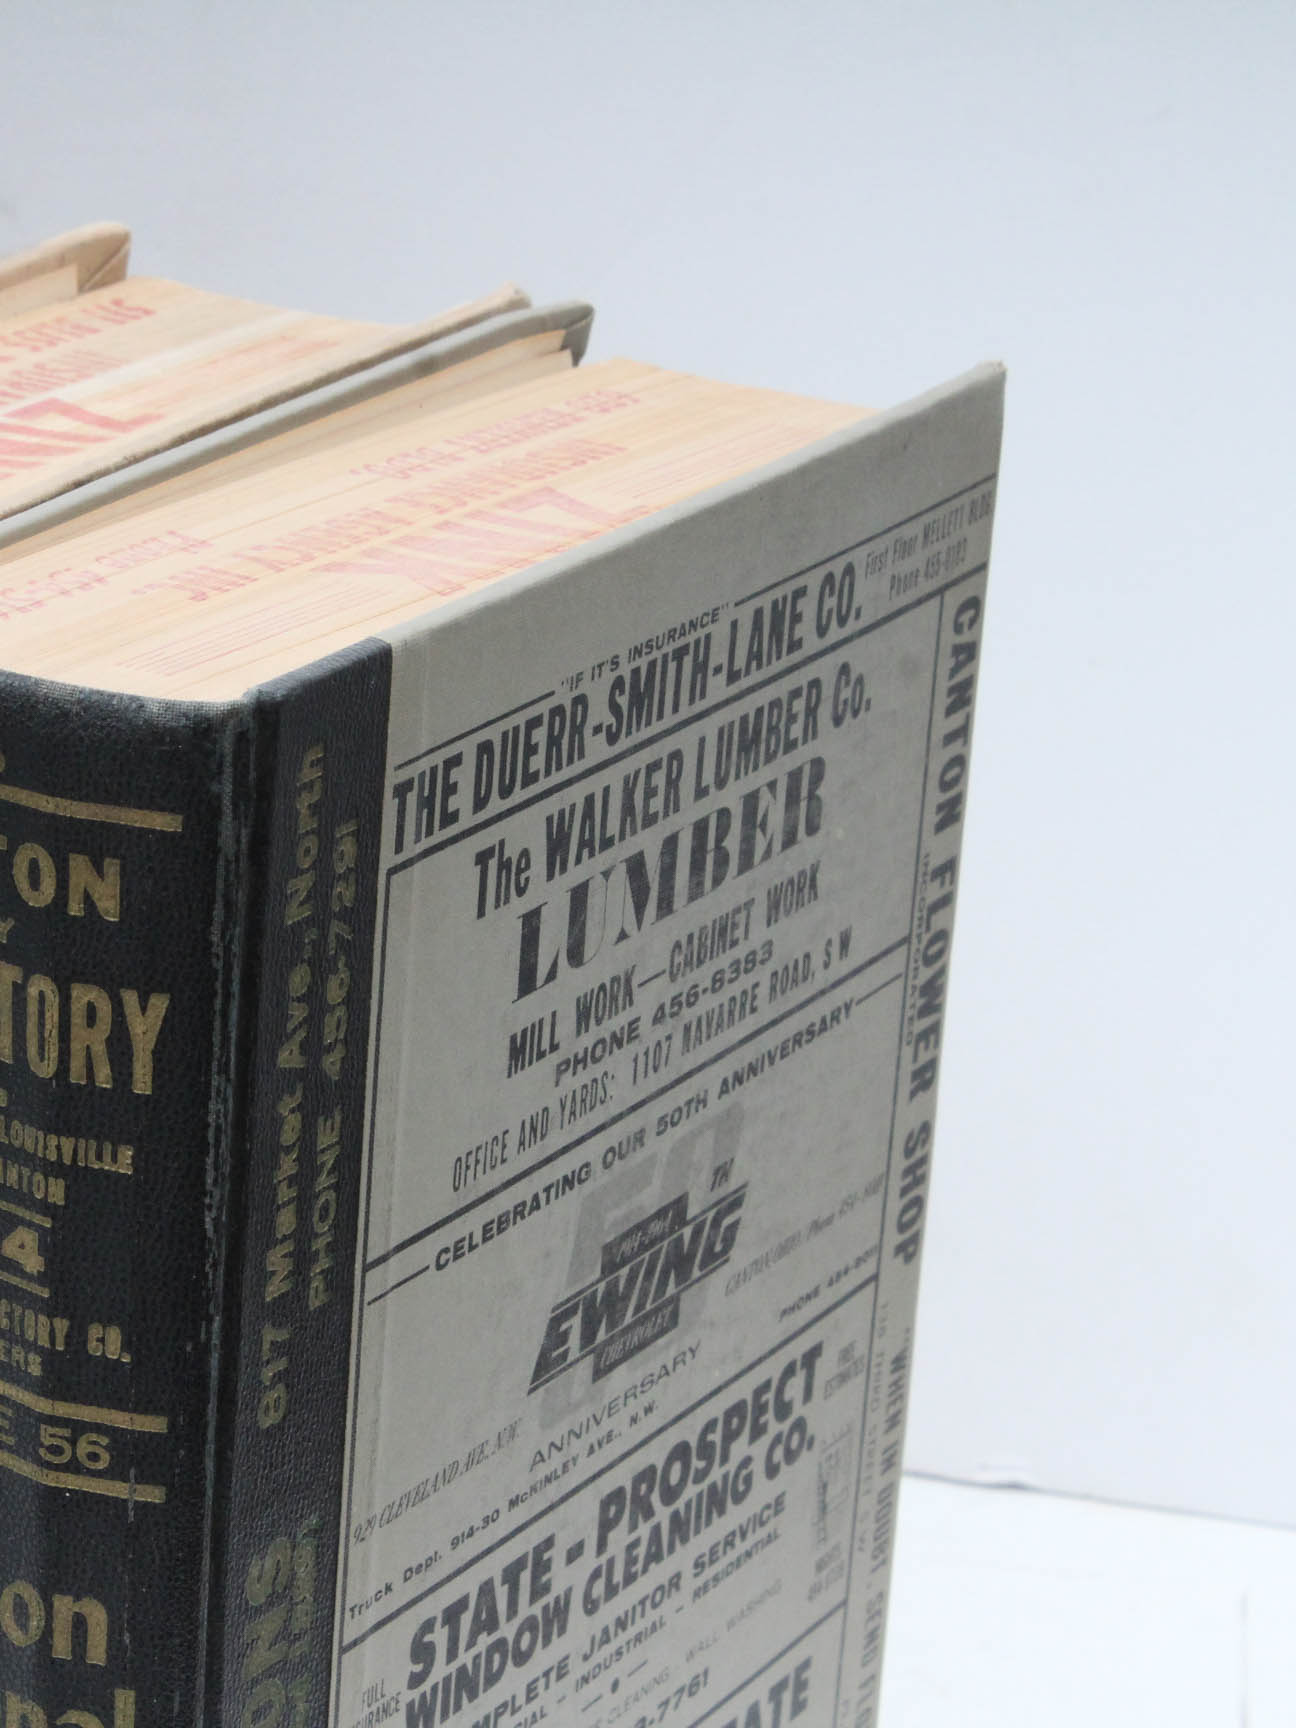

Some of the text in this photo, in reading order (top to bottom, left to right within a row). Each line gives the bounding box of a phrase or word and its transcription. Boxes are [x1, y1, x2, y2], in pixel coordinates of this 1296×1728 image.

[863, 542, 889, 581] First
[891, 527, 919, 566] Floor
[888, 559, 920, 602] Phone
[390, 560, 863, 857] THE DUERR-SMITH-LANE CO.
[590, 651, 620, 683] IT'S
[471, 661, 872, 923] The WALKER LUMBER Co.
[511, 749, 828, 1005] LUMBER
[264, 744, 325, 1302] Market North
[506, 857, 822, 1080] MILL WORK
[553, 935, 774, 1089] PHONE 456-8383
[891, 590, 982, 1276] CANTON FLOWER SHOP
[434, 1157, 592, 1276] CELEBRATING
[601, 1124, 647, 1174] OUR
[655, 1086, 709, 1140] 50TH
[716, 995, 855, 1102] ANNIVERSARY
[451, 944, 817, 1196] OFFICE AND YARDS: 1107 NAVARRE ROAD,
[309, 1104, 342, 1312] PHONE
[530, 1190, 746, 1386] EWING
[87, 1322, 132, 1364] CO.
[528, 1336, 701, 1474] ANNIVERSARY
[38, 1424, 112, 1471] 56
[347, 1395, 658, 1625] Truck Dept. 914-30 McKINLEY N.W.
[352, 1456, 460, 1549] 929 CLEVELAND
[405, 1530, 556, 1696] STATE
[595, 1336, 825, 1560] PROSPECT
[878, 1436, 899, 1478] IN
[403, 1582, 572, 1728] WINDOW
[581, 1448, 755, 1623] CLEANING
[764, 1413, 817, 1481] CO.
[573, 1611, 667, 1696] INDUSTRIAL
[691, 1522, 782, 1606] RESIDENTIAL
[582, 1567, 683, 1664] JANITOR
[691, 1488, 787, 1582] SERVICE
[361, 1676, 385, 1714] FULL
[607, 1663, 670, 1726] CLEANING
